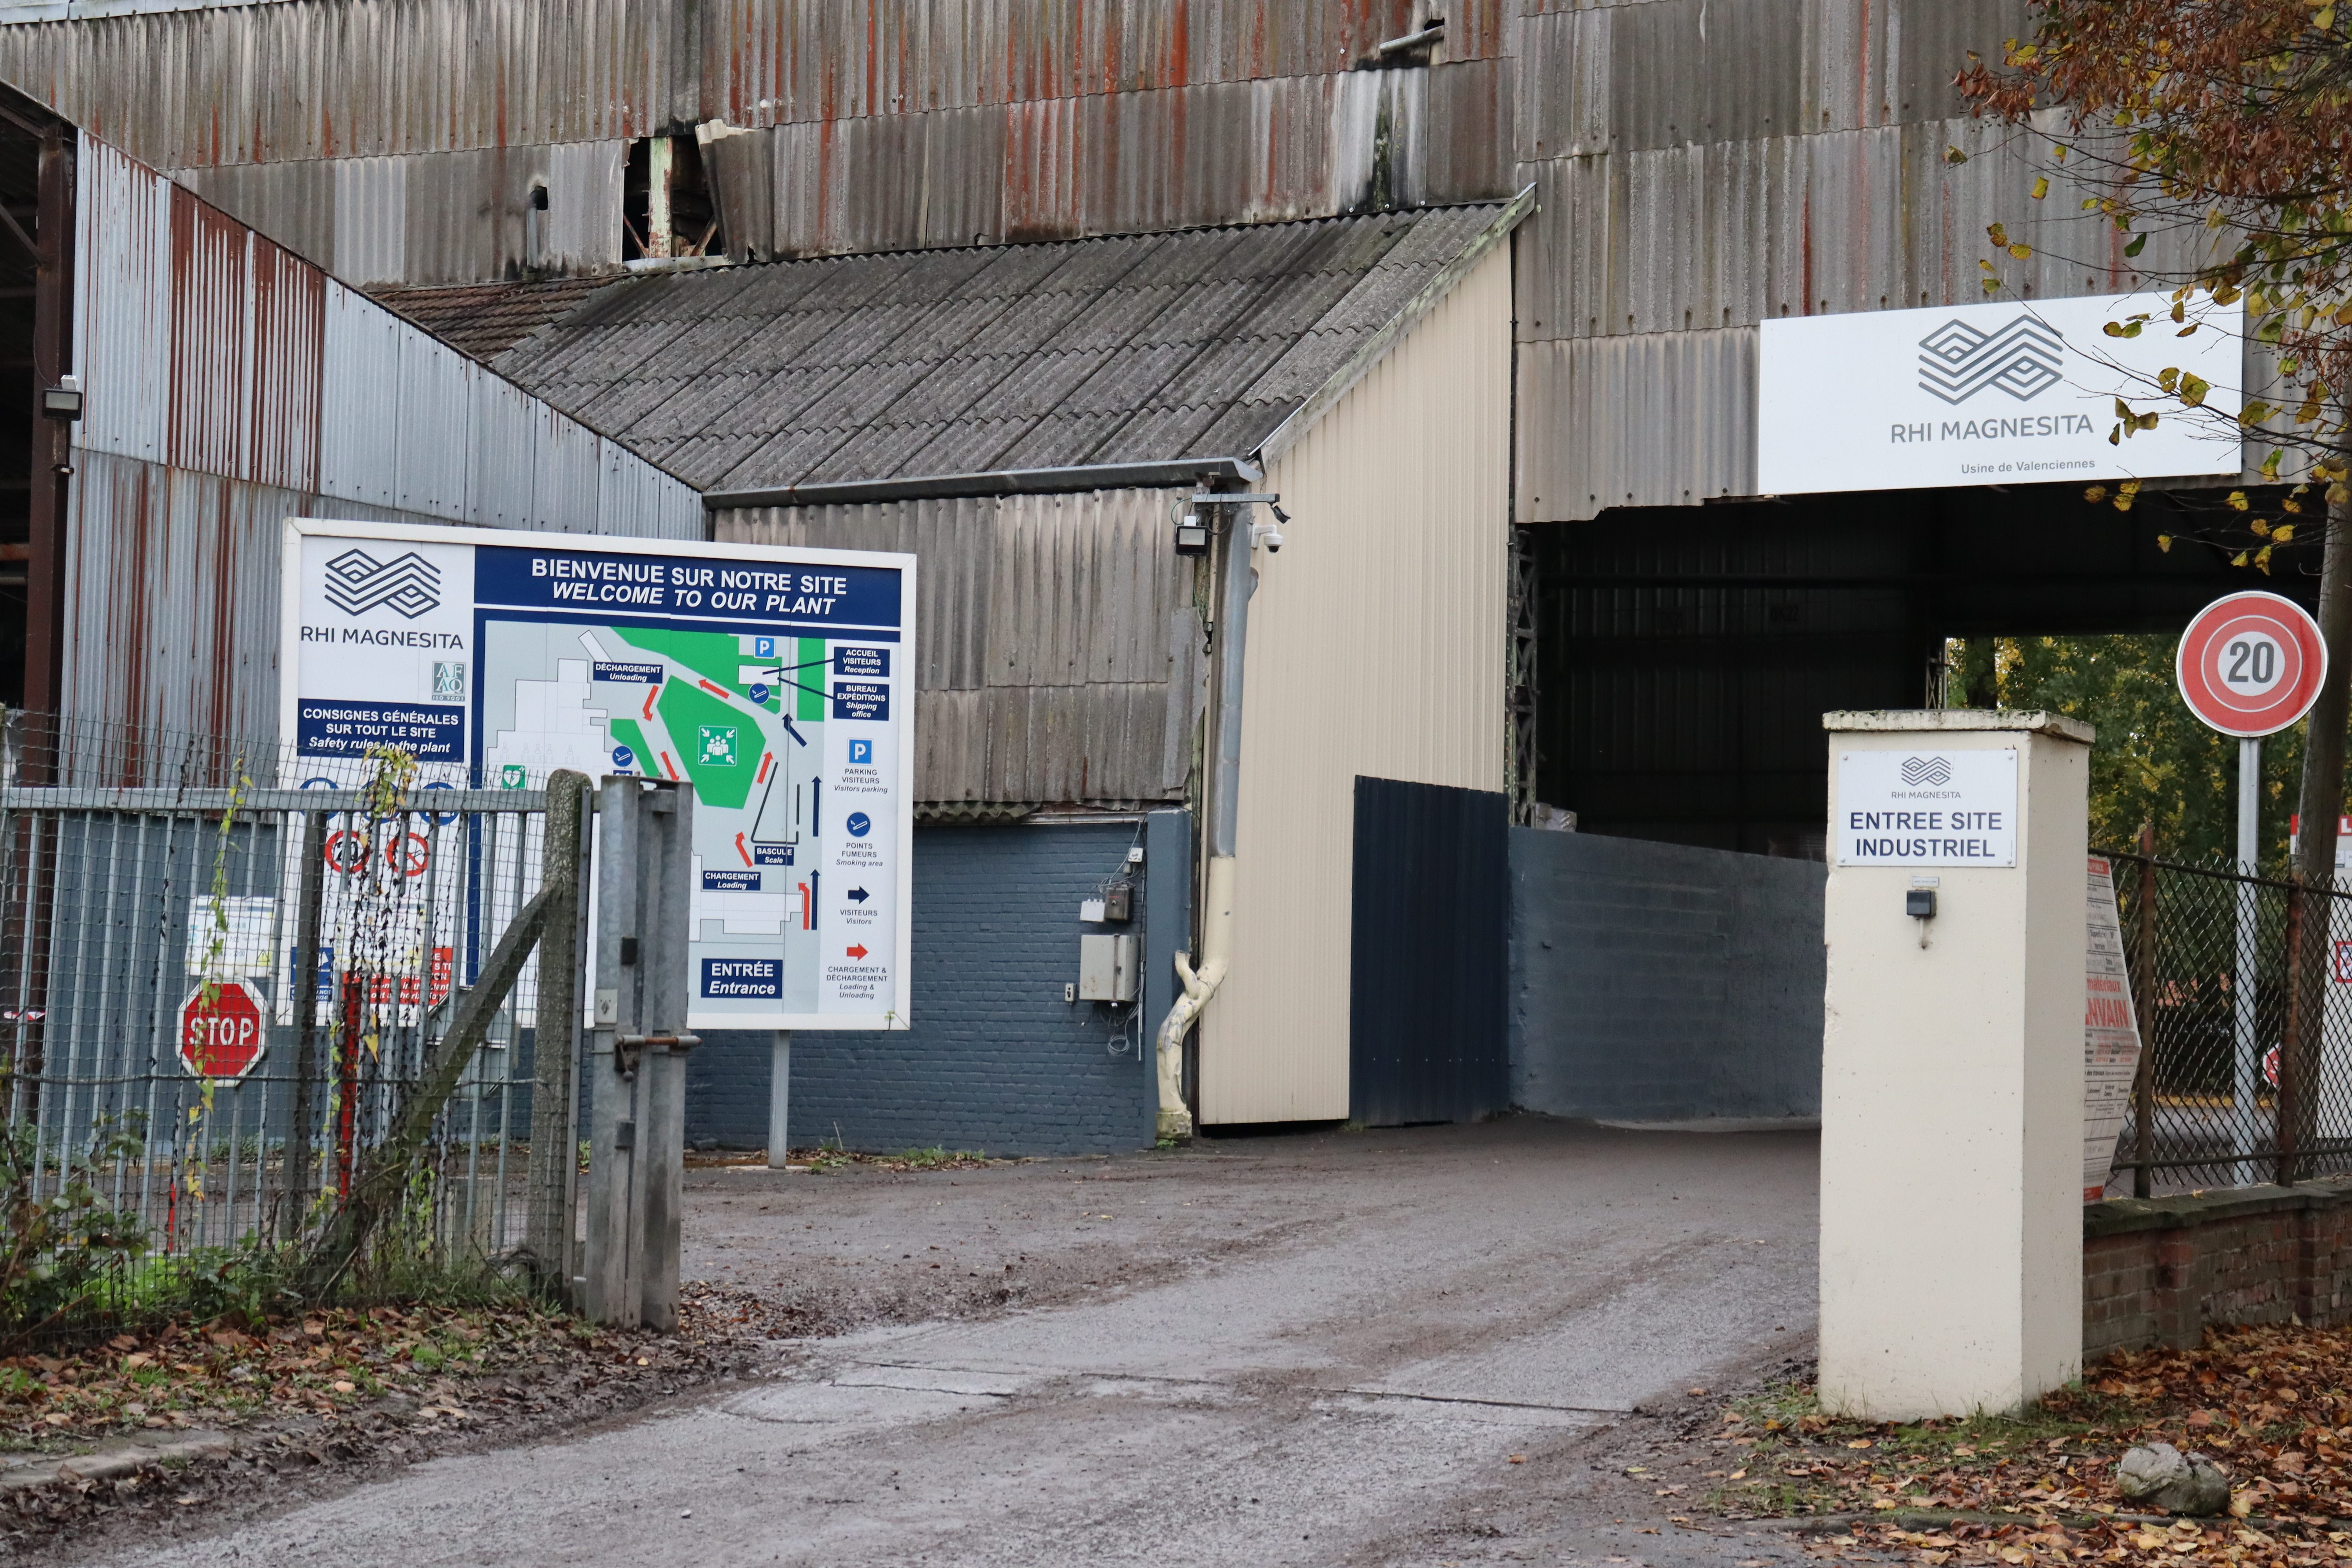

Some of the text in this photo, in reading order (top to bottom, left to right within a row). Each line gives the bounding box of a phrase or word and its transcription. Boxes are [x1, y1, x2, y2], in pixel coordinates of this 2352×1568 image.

[1891, 414, 2094, 443] RHI MAGNESITA
[1962, 460, 2095, 474] Usine de Valenciennes
[532, 559, 847, 595] BIENVENUE SUR NOTRE SITE
[554, 581, 836, 615] WELCOME TO OUR PLANT
[301, 626, 463, 649] RHI MAGNESITA
[595, 662, 661, 673] DÉCHARGEMENT
[843, 657, 881, 666] VISITEURS
[2228, 641, 2274, 683] 20
[610, 673, 647, 683] Unloading
[844, 666, 880, 675] Reception
[837, 692, 886, 702] EXPÉDITIONS
[846, 702, 877, 711] Shipping
[303, 708, 459, 725] CONSIGNES GÉNÉRALES
[326, 723, 436, 738] SUR TOUT LE SITE
[309, 737, 450, 754] Safety rules in the plant
[1851, 812, 2002, 830] ENTREE SITE
[1857, 839, 1995, 857] INDUSTRIEL
[836, 859, 866, 867] Smoking
[705, 872, 759, 880] CHARGEMENT
[717, 881, 747, 890] Loading
[711, 961, 773, 977] ENTRÉE
[709, 981, 775, 995] Entrance
[189, 1017, 254, 1045] STOP
